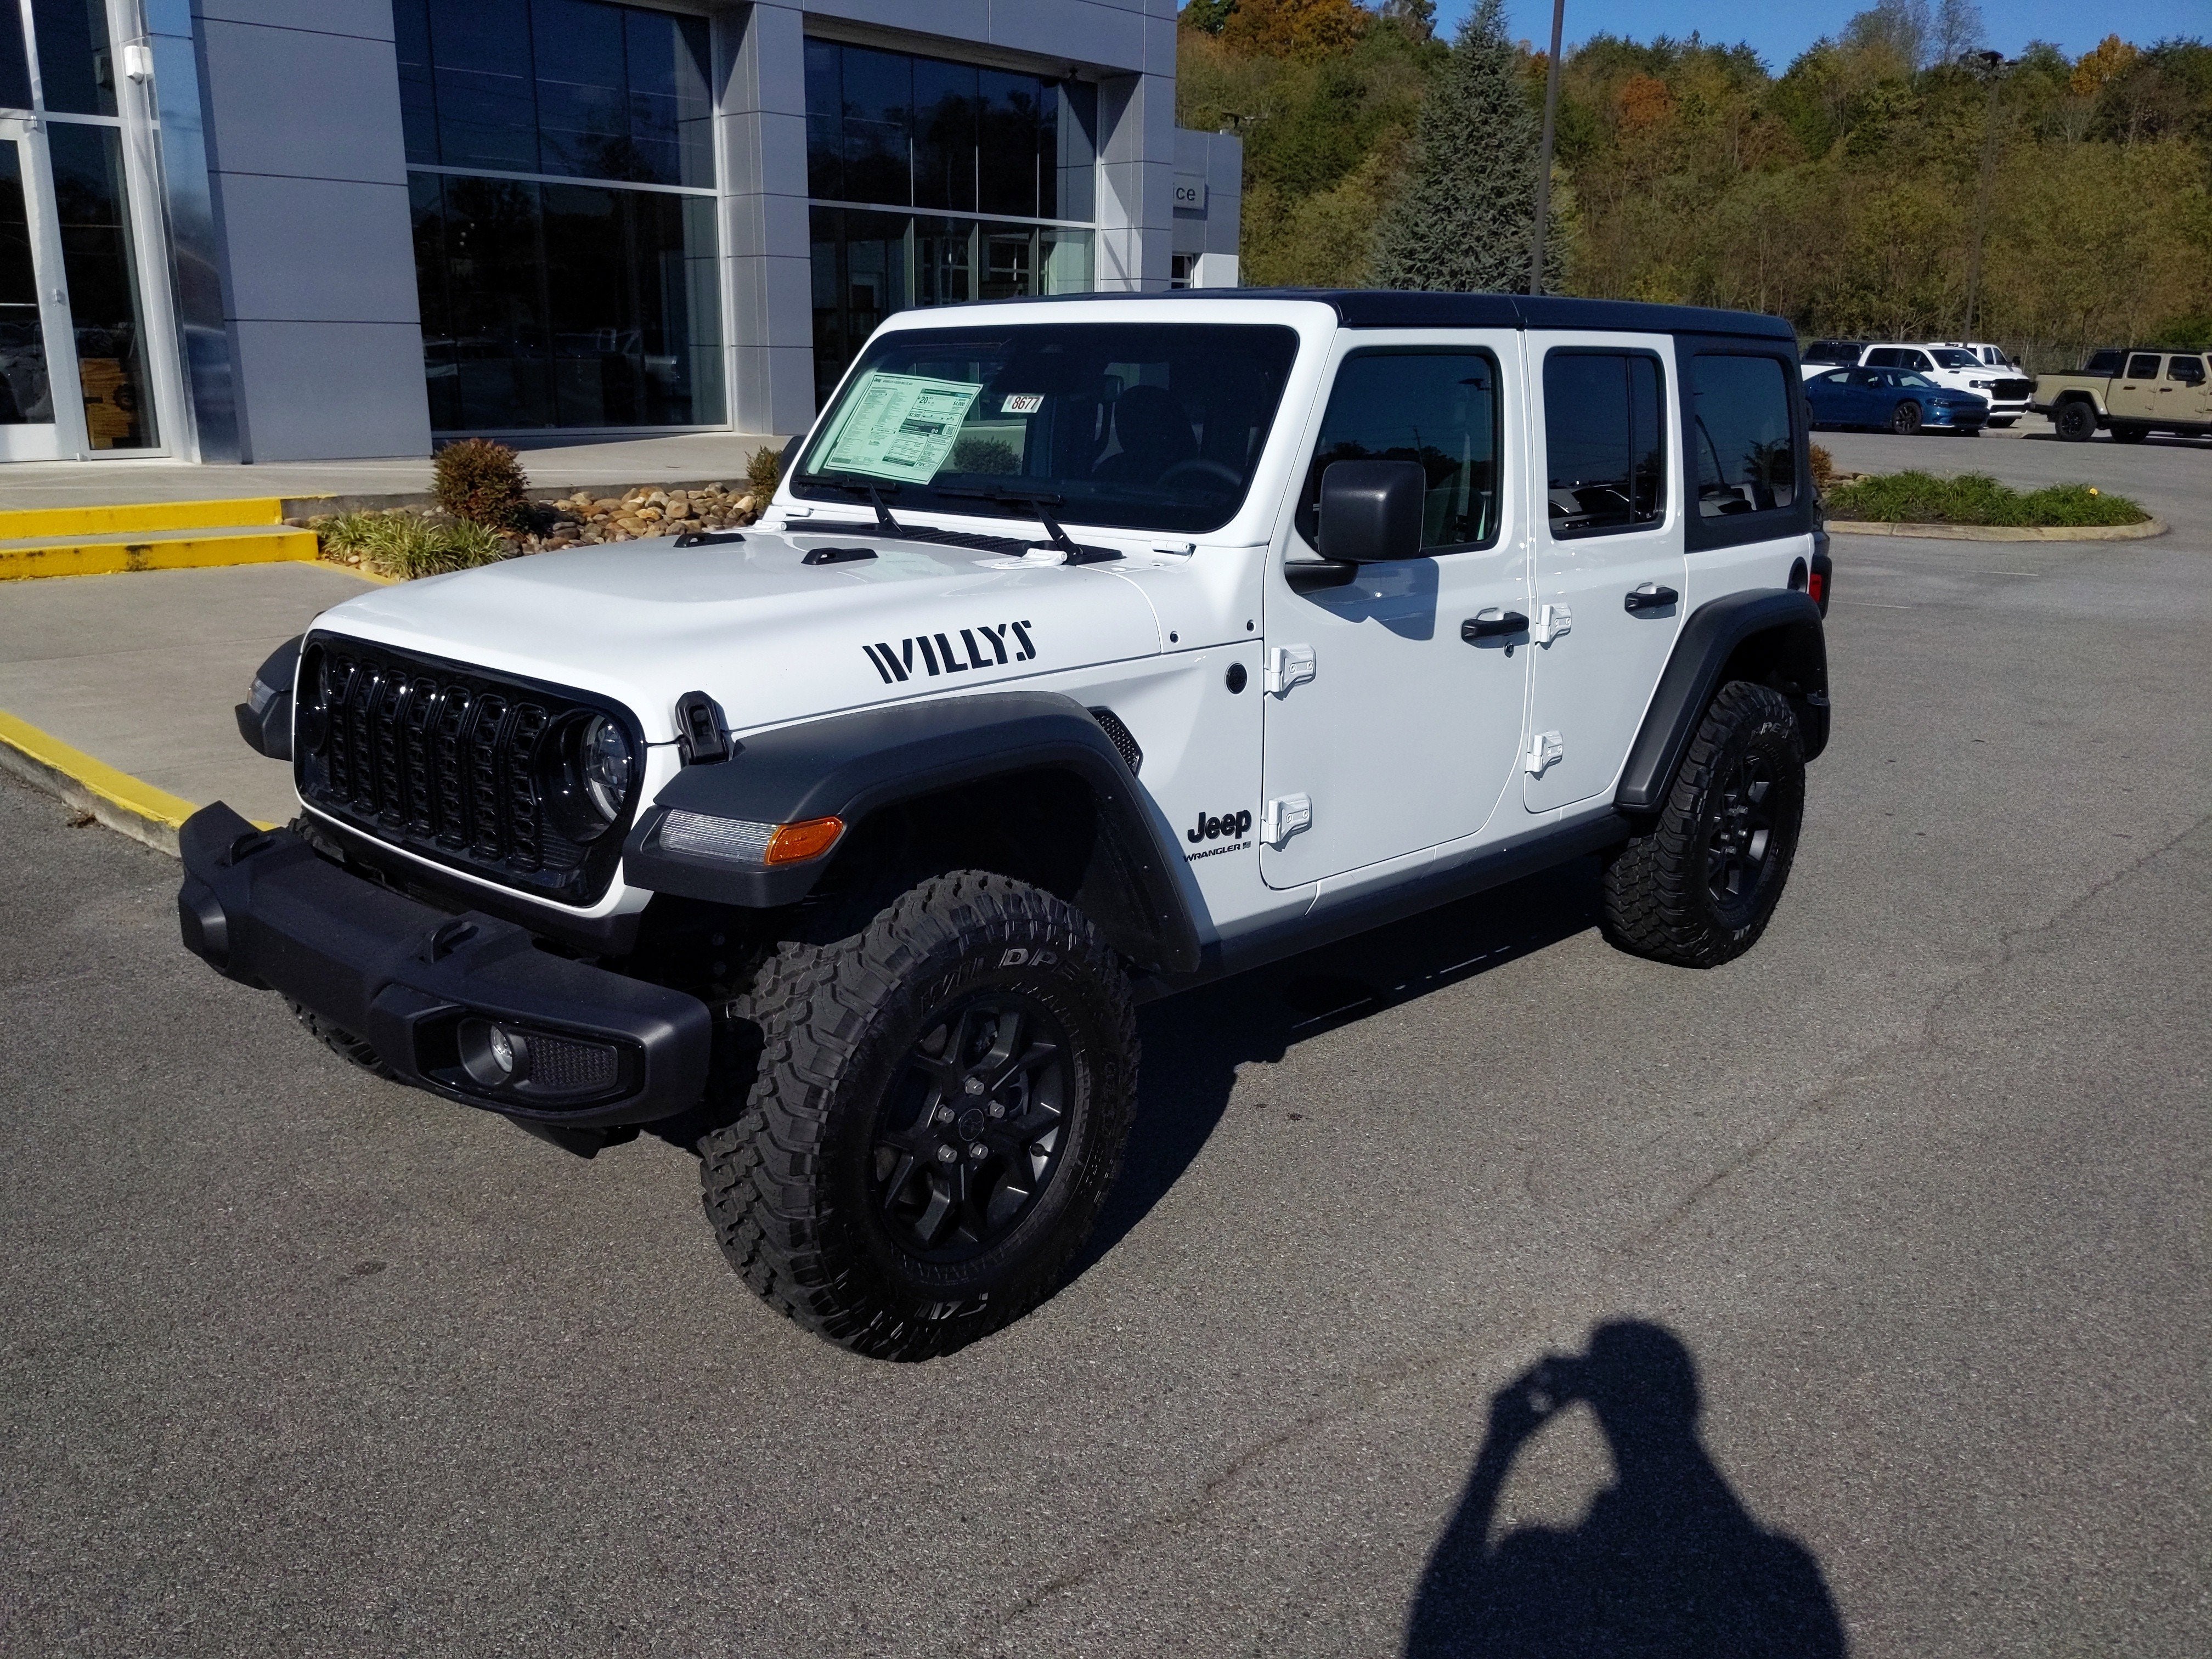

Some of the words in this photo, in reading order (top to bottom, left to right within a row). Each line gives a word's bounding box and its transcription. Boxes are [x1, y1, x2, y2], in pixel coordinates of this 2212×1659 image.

[1012, 397, 1040, 409] 8677
[862, 620, 1036, 684] WILLYS
[1187, 810, 1252, 843] Jeep
[1183, 843, 1242, 862] WRANGLER
